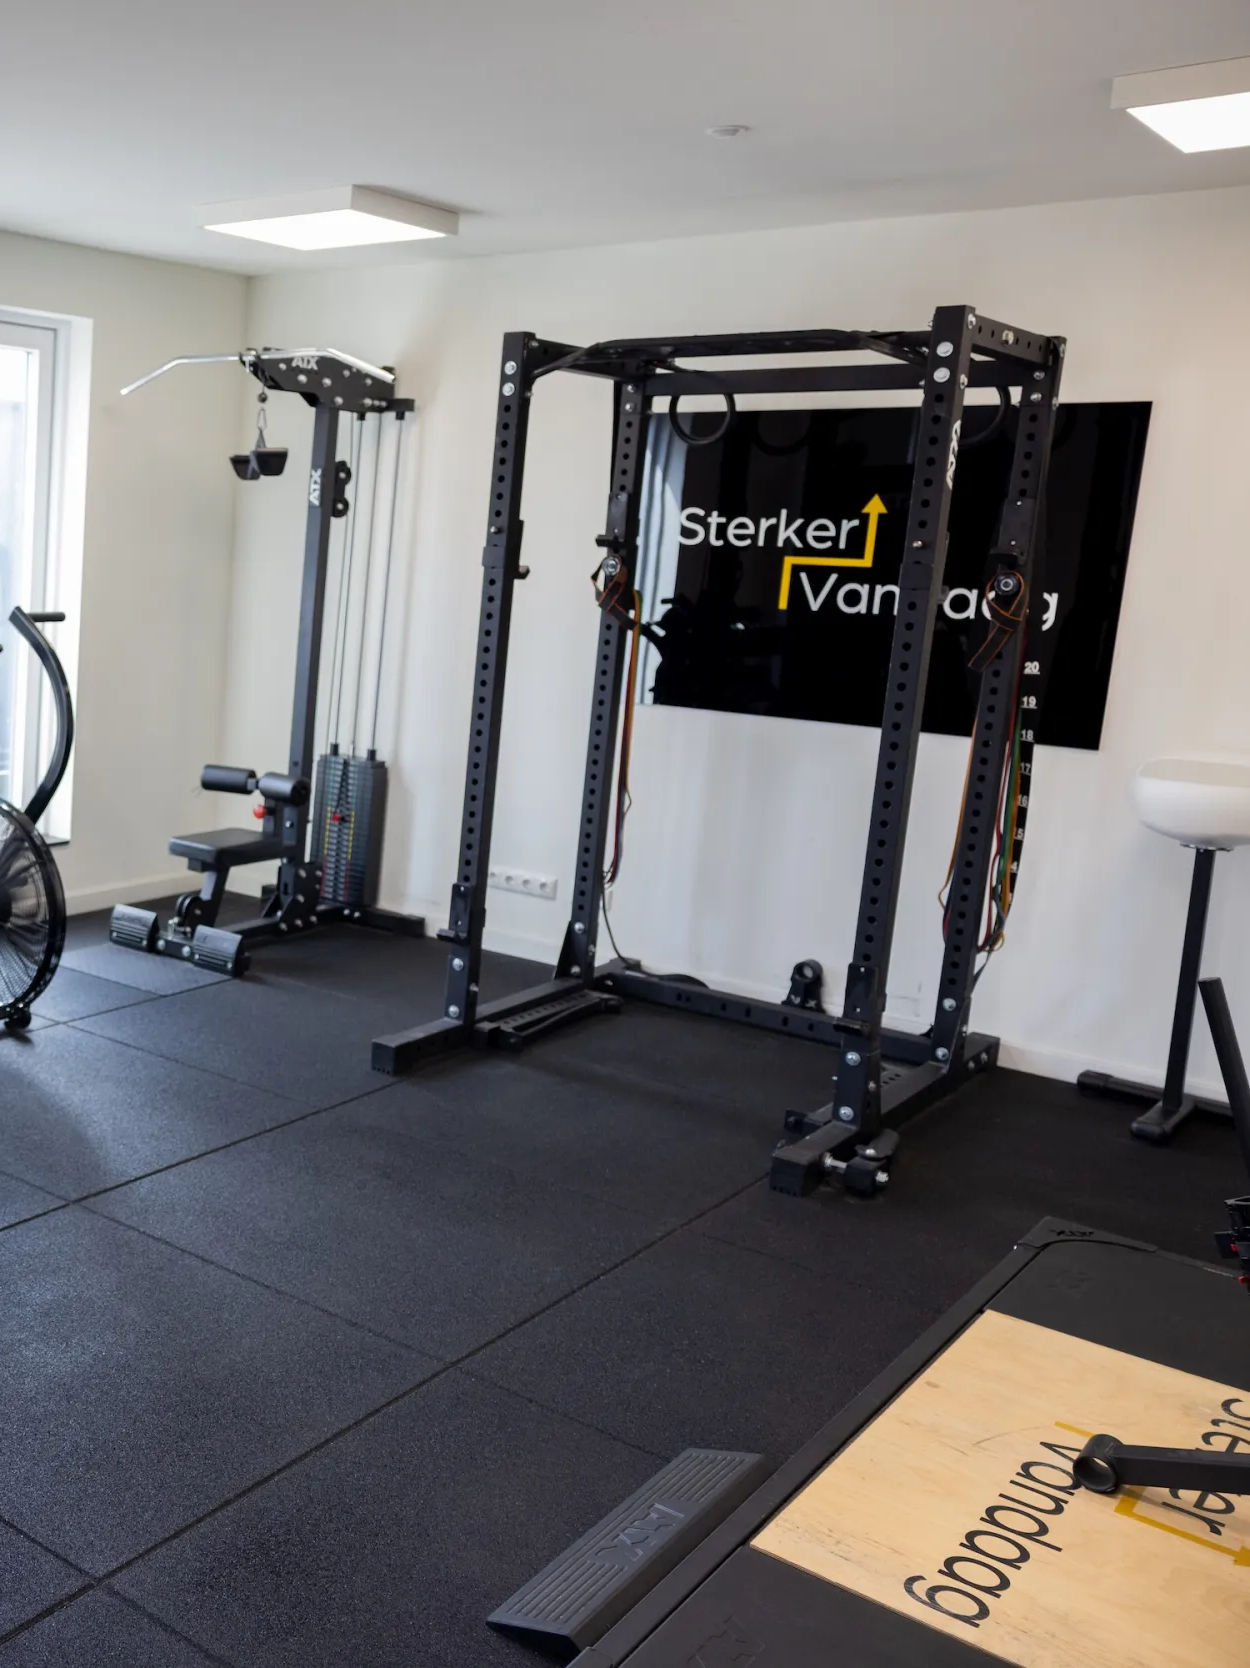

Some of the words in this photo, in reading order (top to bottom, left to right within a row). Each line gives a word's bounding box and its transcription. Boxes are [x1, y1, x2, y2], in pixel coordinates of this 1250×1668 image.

[308, 467, 323, 506] ATX
[679, 505, 860, 550] Sterker
[1023, 660, 1040, 673] 20
[1022, 695, 1037, 708] 19
[1021, 729, 1034, 741] 18
[1020, 761, 1031, 774] 17
